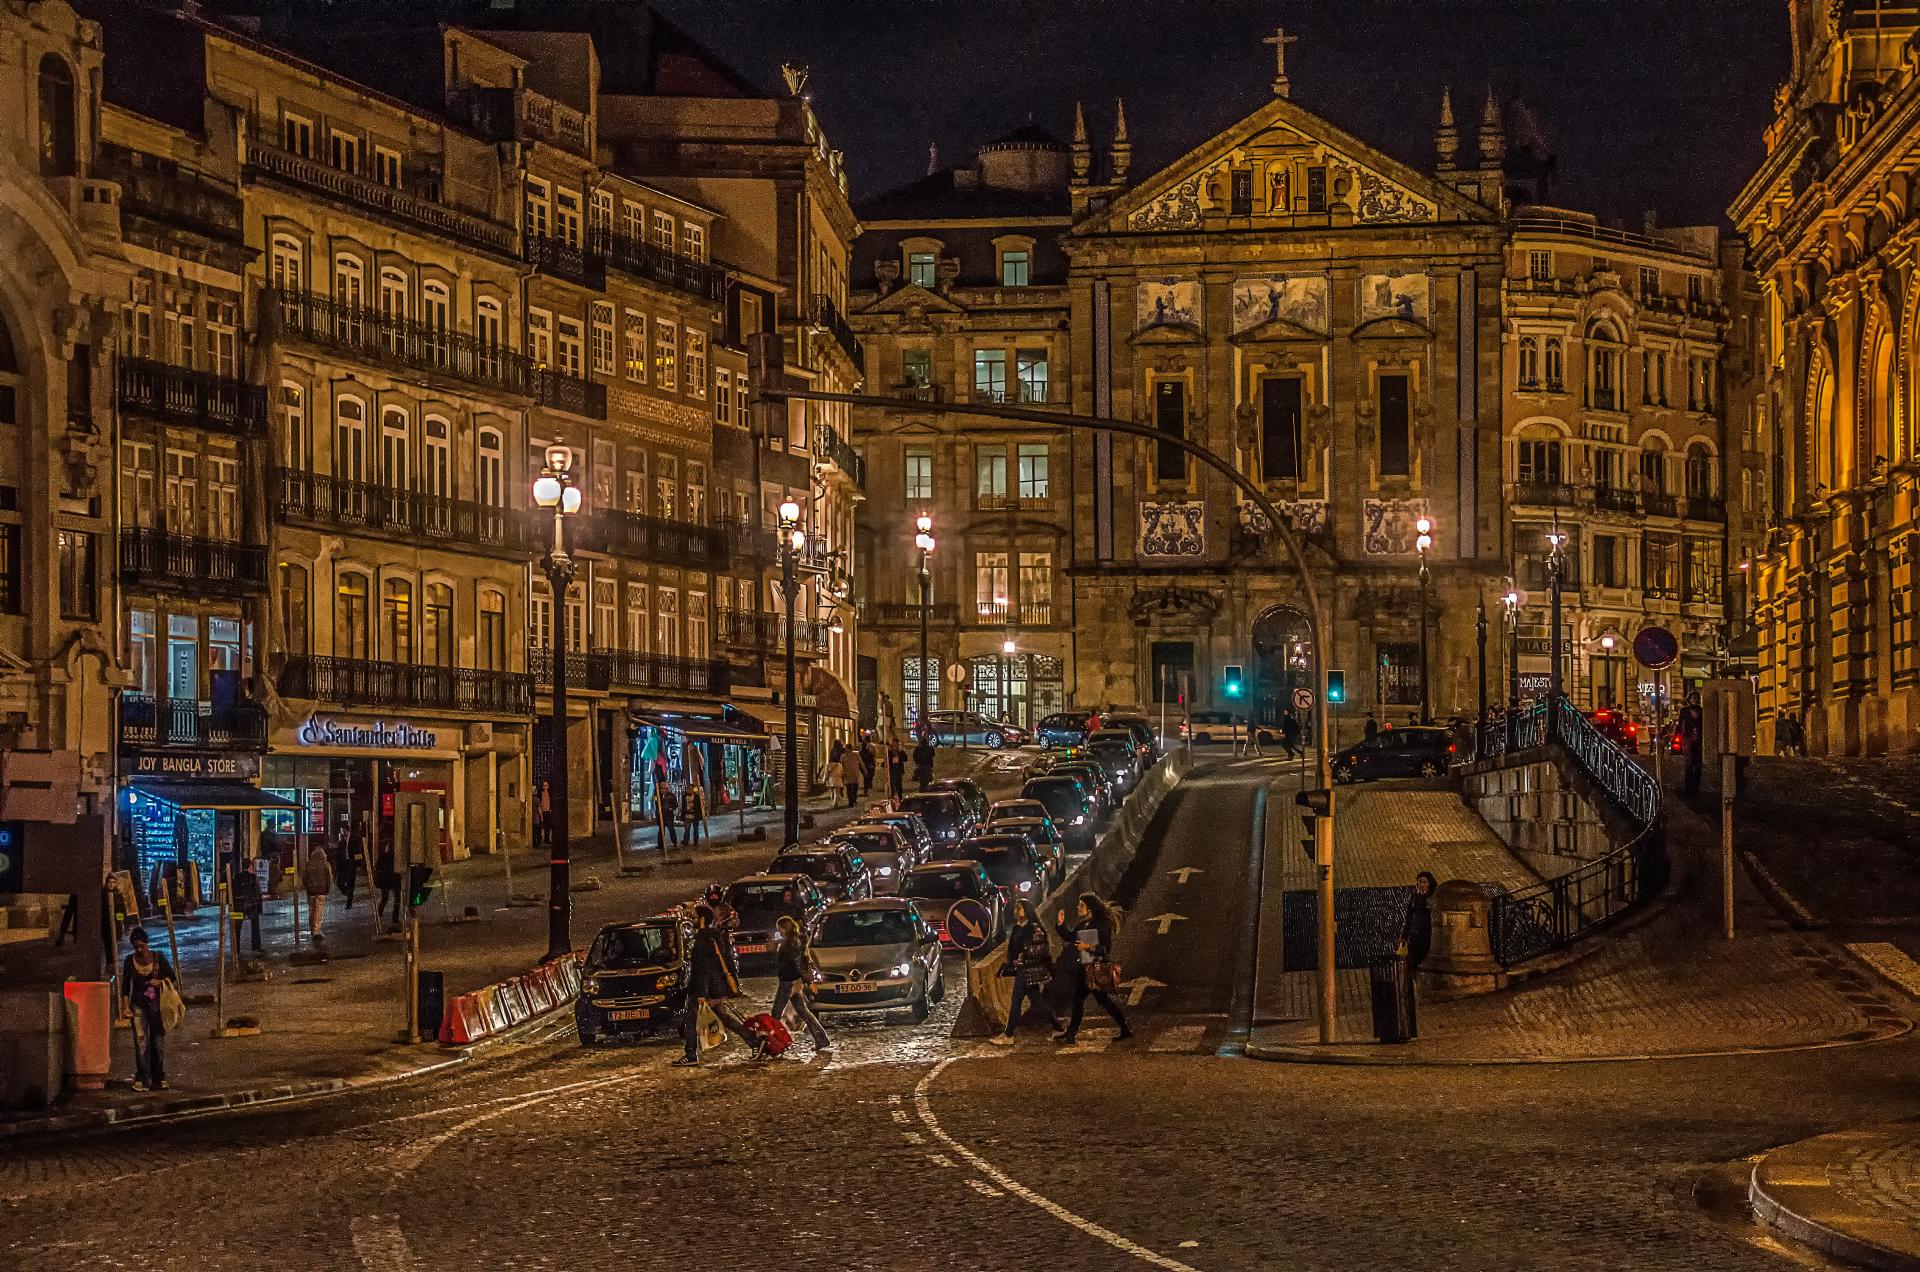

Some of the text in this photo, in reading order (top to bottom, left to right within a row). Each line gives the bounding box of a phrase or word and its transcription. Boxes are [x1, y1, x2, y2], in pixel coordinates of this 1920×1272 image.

[323, 720, 437, 748] Santander Totta
[138, 756, 236, 773] JOY BANGLA STORE
